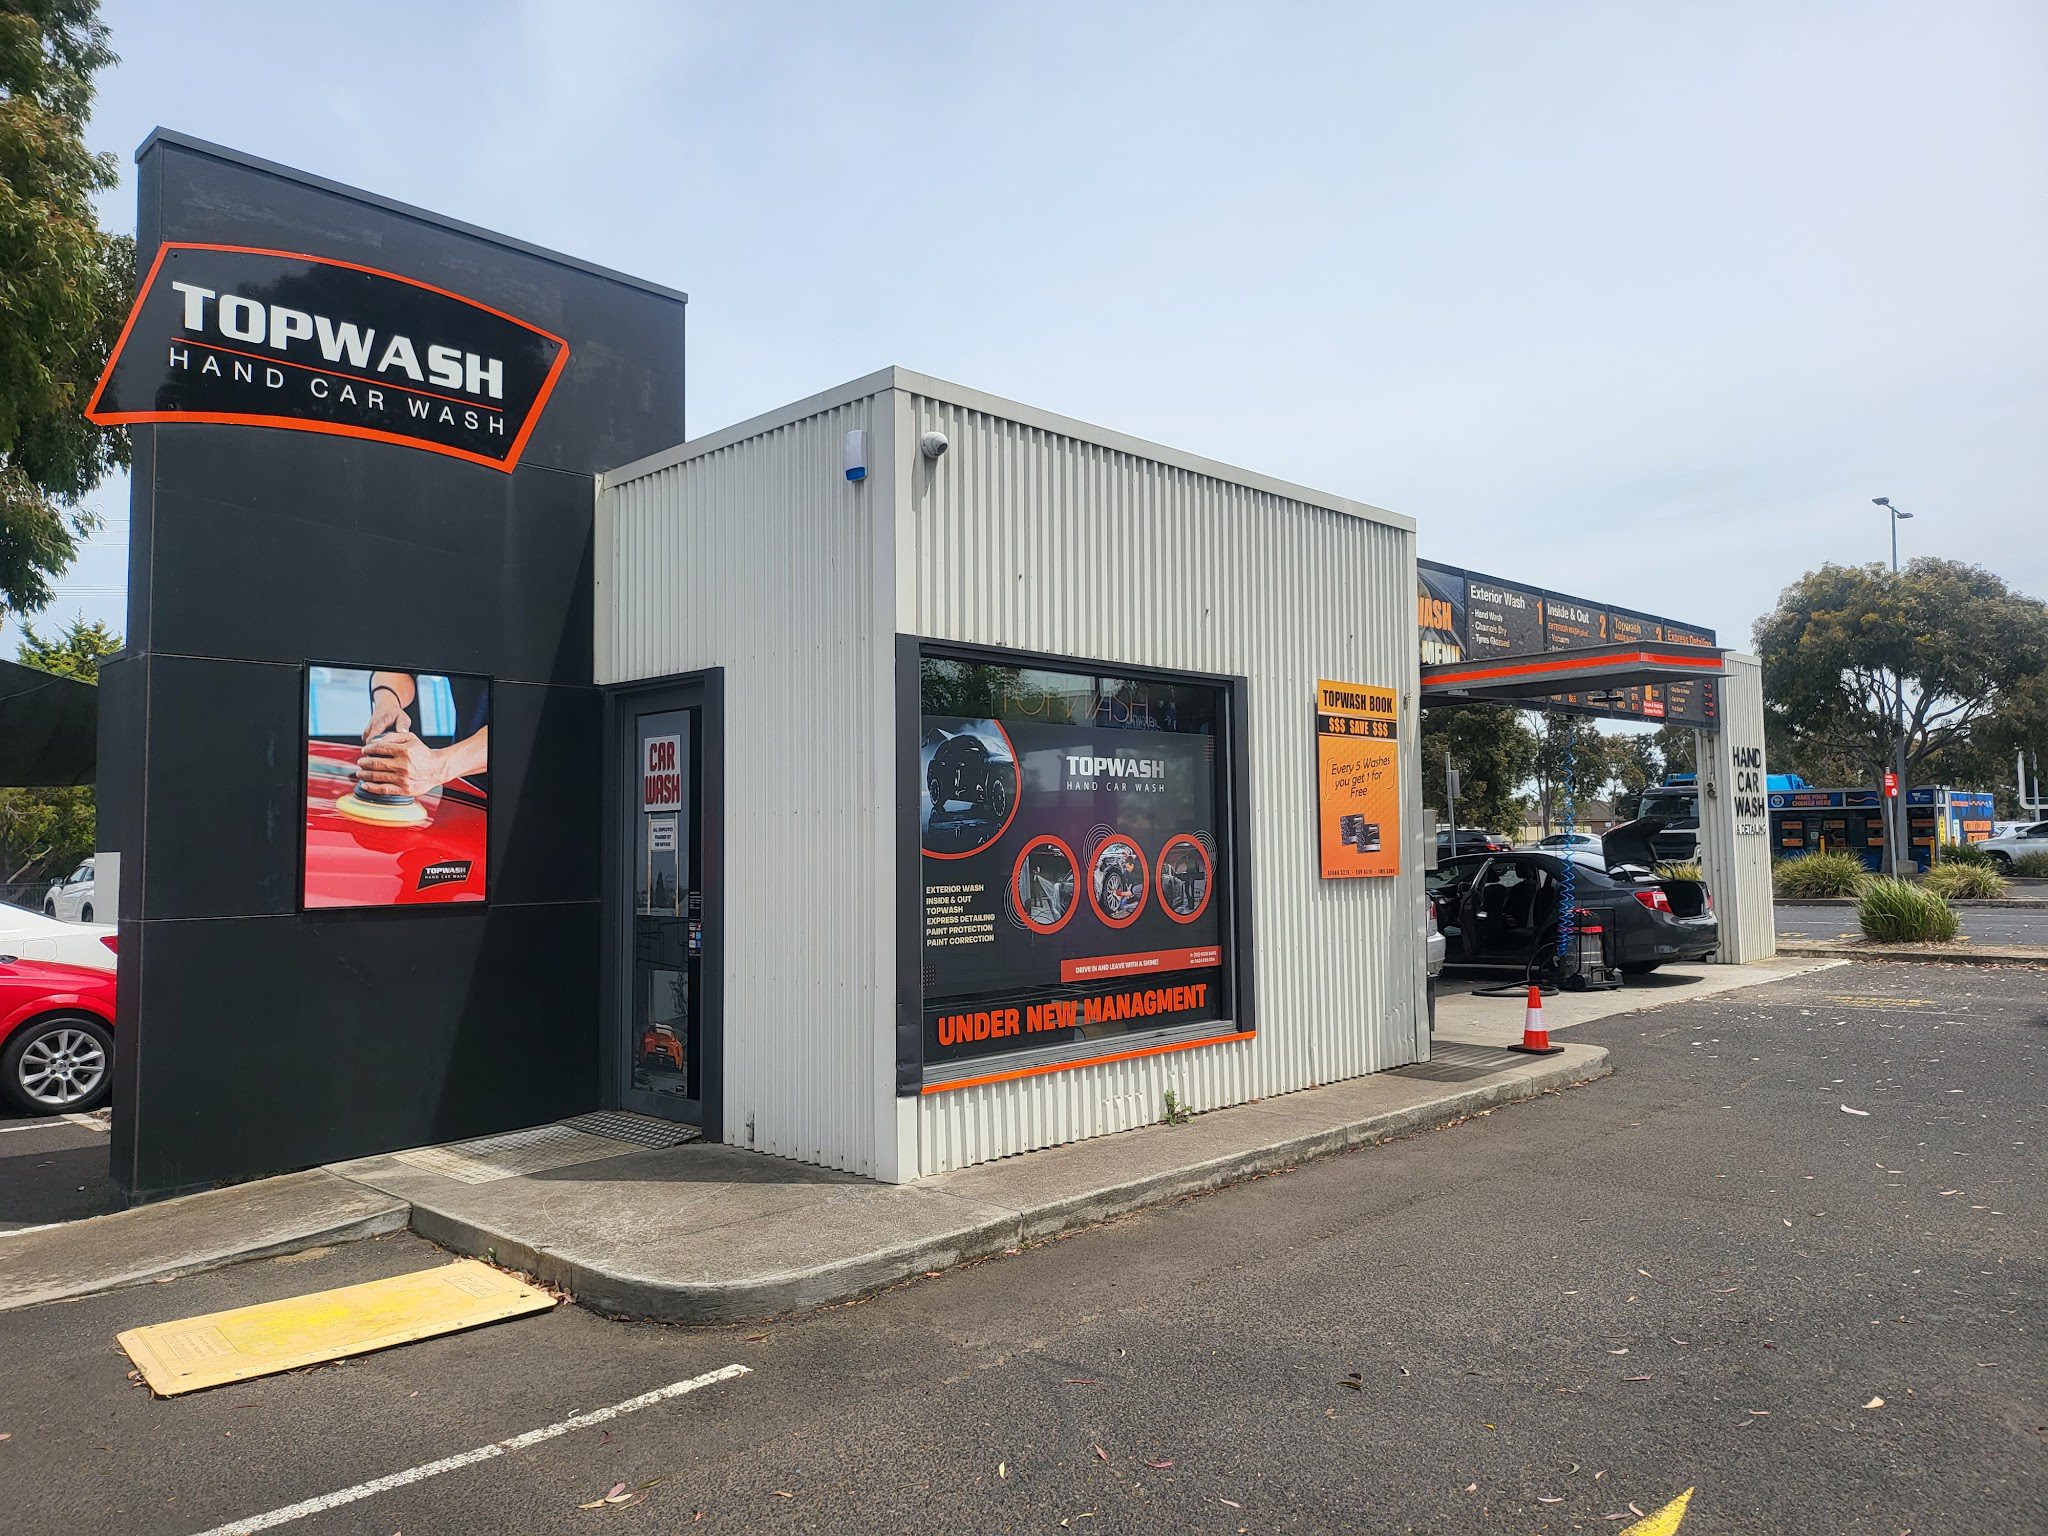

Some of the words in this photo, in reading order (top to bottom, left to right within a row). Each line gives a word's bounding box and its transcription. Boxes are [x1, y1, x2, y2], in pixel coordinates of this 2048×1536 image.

[172, 280, 504, 399] TOPWASH
[169, 346, 284, 389] HAND
[310, 378, 385, 410] CAR
[407, 397, 505, 436] WASH
[1470, 585, 1503, 605] Exterior
[1503, 592, 1526, 609] Wash
[1475, 608, 1489, 620] Hand
[1489, 611, 1503, 622] Wash
[1536, 600, 1543, 625] 1
[1547, 602, 1569, 619] Inside
[1570, 607, 1576, 621] &
[1576, 609, 1590, 624] Out
[1600, 613, 1607, 639] 2
[1614, 616, 1642, 634] Topwash
[1667, 629, 1689, 645] Express
[1322, 689, 1367, 711] TOPWASH
[1369, 695, 1393, 714] BOOK
[1328, 716, 1346, 734] $$$
[1349, 719, 1369, 735] SAVE
[1372, 721, 1389, 738] $$$
[649, 742, 675, 772] CAR
[1066, 755, 1165, 778] TOPWASH
[1331, 763, 1354, 775] Every
[1356, 760, 1361, 771] 5
[1363, 756, 1391, 770] Washes
[1732, 745, 1761, 769] HAND
[645, 774, 680, 805] WASH
[1066, 780, 1099, 791] HAND
[1106, 782, 1127, 792] CAR
[1135, 783, 1165, 793] WASH
[1335, 778, 1350, 791] you
[1352, 773, 1365, 787] get
[1372, 769, 1383, 781] for
[1737, 771, 1760, 793] CAR
[1350, 786, 1368, 799] Free
[1734, 796, 1765, 818] WASH
[425, 866, 466, 875] TOPWASH
[926, 885, 961, 894] EXTERIOR
[962, 884, 984, 893] WASH
[926, 896, 950, 905] INSIDE
[950, 896, 956, 904] &
[957, 895, 972, 903] OUT
[926, 906, 964, 915] TOPWASH
[926, 915, 959, 925] EXPRESS
[960, 913, 996, 923] DETAILING
[926, 927, 948, 936] PAINT
[948, 924, 993, 935] PROTECTION
[926, 938, 948, 947] PAINT
[949, 934, 995, 945] CORRECTION
[1075, 966, 1092, 974] DRIVE
[1098, 964, 1110, 972] AND
[1109, 962, 1125, 970] LEAVE
[1125, 960, 1139, 969] WITH
[938, 1007, 1020, 1047] UNDER
[1026, 999, 1078, 1034] NEW
[1083, 983, 1207, 1025] MANAGMENT
